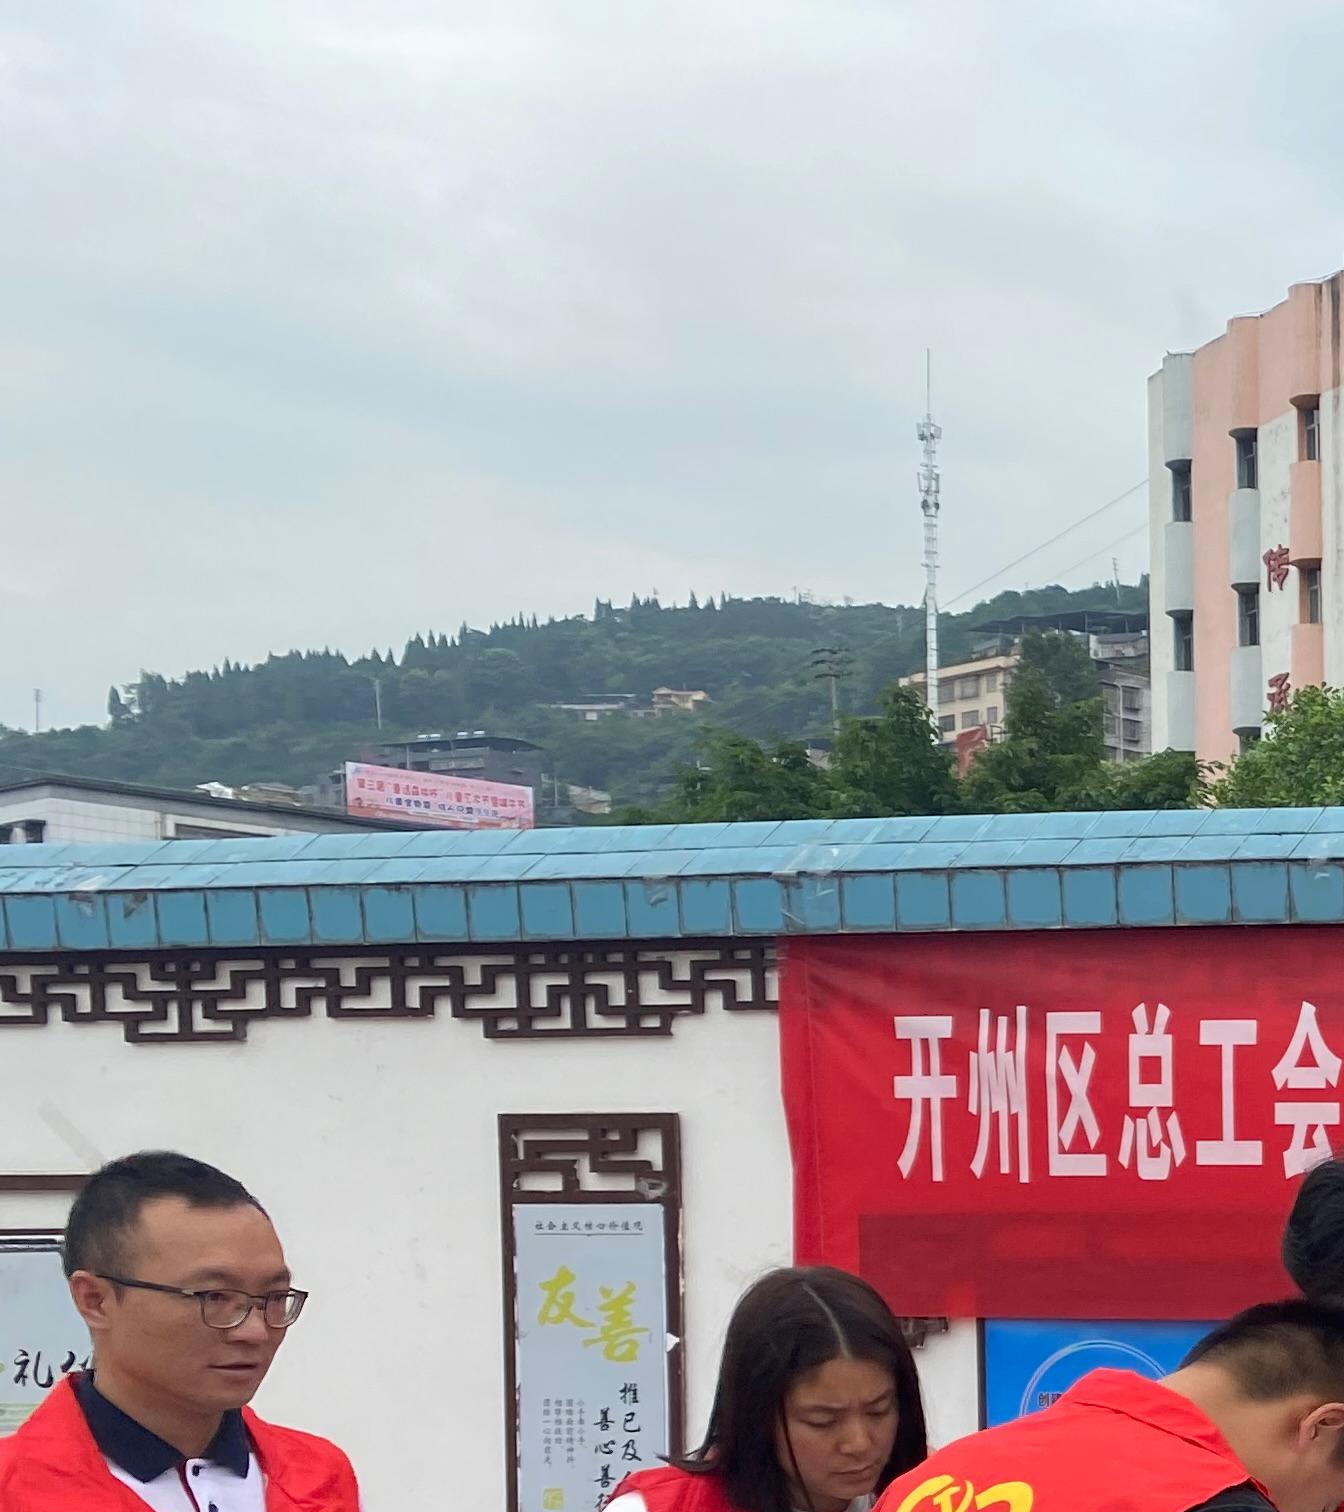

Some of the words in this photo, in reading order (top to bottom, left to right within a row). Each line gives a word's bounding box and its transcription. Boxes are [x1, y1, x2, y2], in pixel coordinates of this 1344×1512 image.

[535, 1220, 644, 1231] 社会主义核心价值观
[537, 1265, 649, 1362] 友善
[618, 1382, 643, 1476] 推己及
